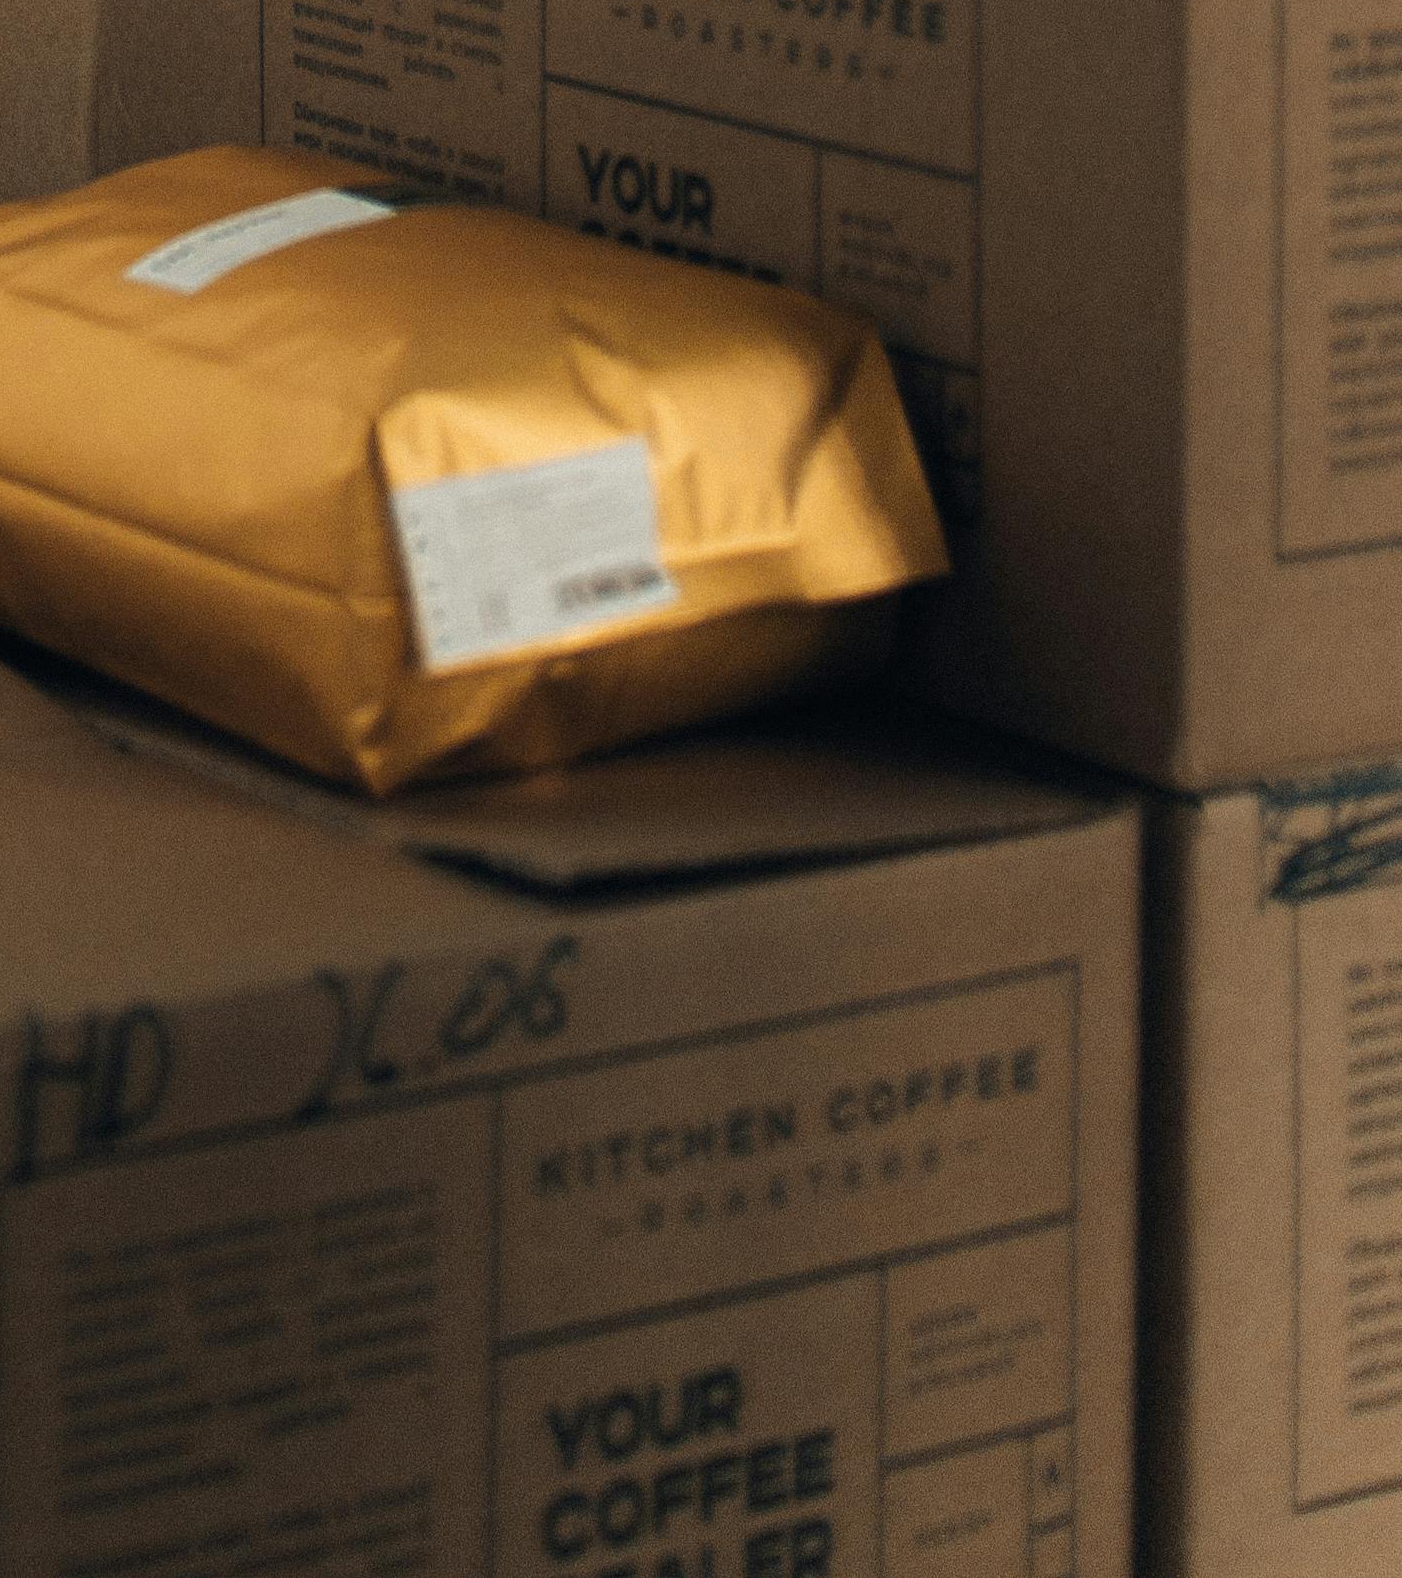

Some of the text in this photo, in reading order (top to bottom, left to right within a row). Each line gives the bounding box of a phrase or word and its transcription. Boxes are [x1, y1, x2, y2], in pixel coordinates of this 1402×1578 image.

[576, 141, 715, 237] YOUR
[545, 1366, 741, 1469] YOUR
[543, 1427, 836, 1562] COFFEE
